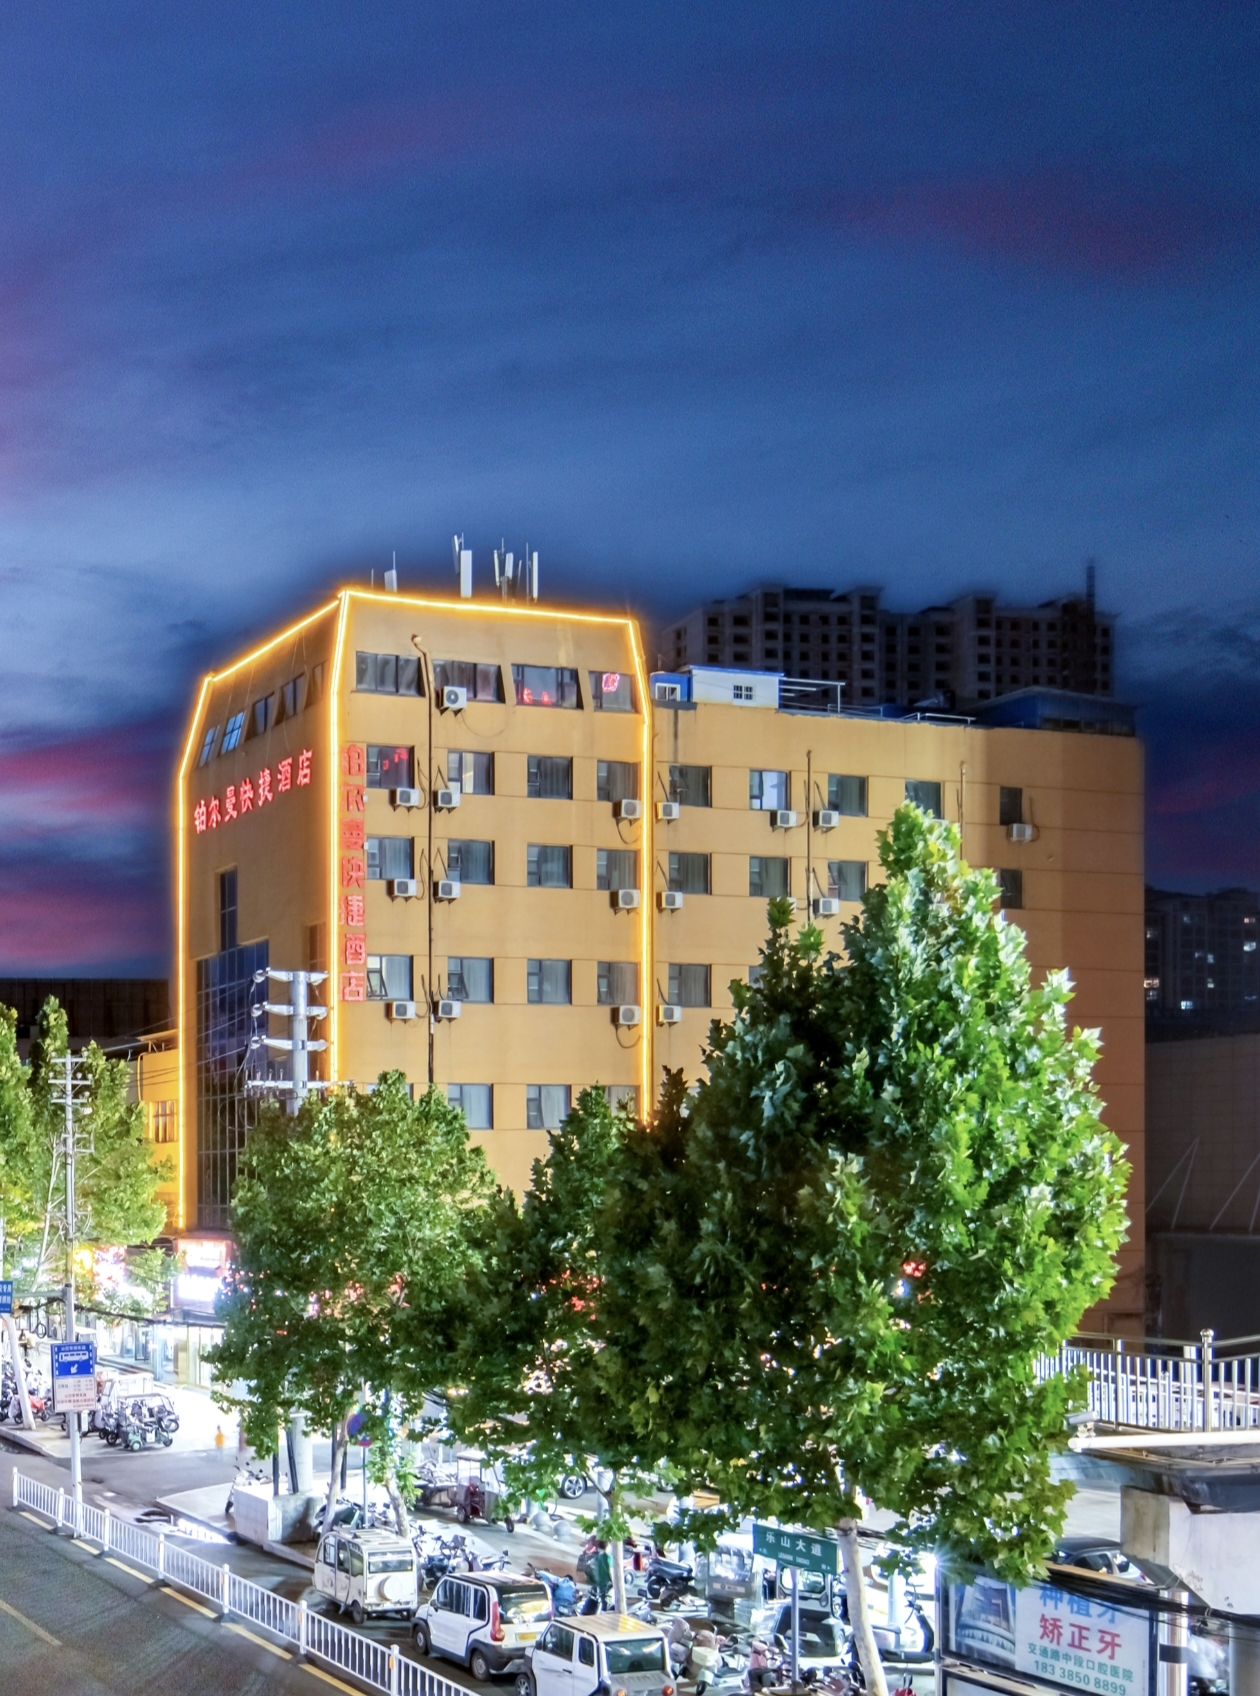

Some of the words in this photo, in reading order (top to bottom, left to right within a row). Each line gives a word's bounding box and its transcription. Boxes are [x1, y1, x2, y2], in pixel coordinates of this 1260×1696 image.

[193, 749, 314, 835] 铂尔曼快捷酒店
[766, 1531, 822, 1556] 乐山大道
[1039, 1613, 1122, 1661] 矫正牙
[1028, 1642, 1134, 1682] 交通路中段口腔医院
[1034, 1660, 1056, 1676] 183
[1059, 1667, 1090, 1686] 3850
[1093, 1677, 1126, 1696] 8899
